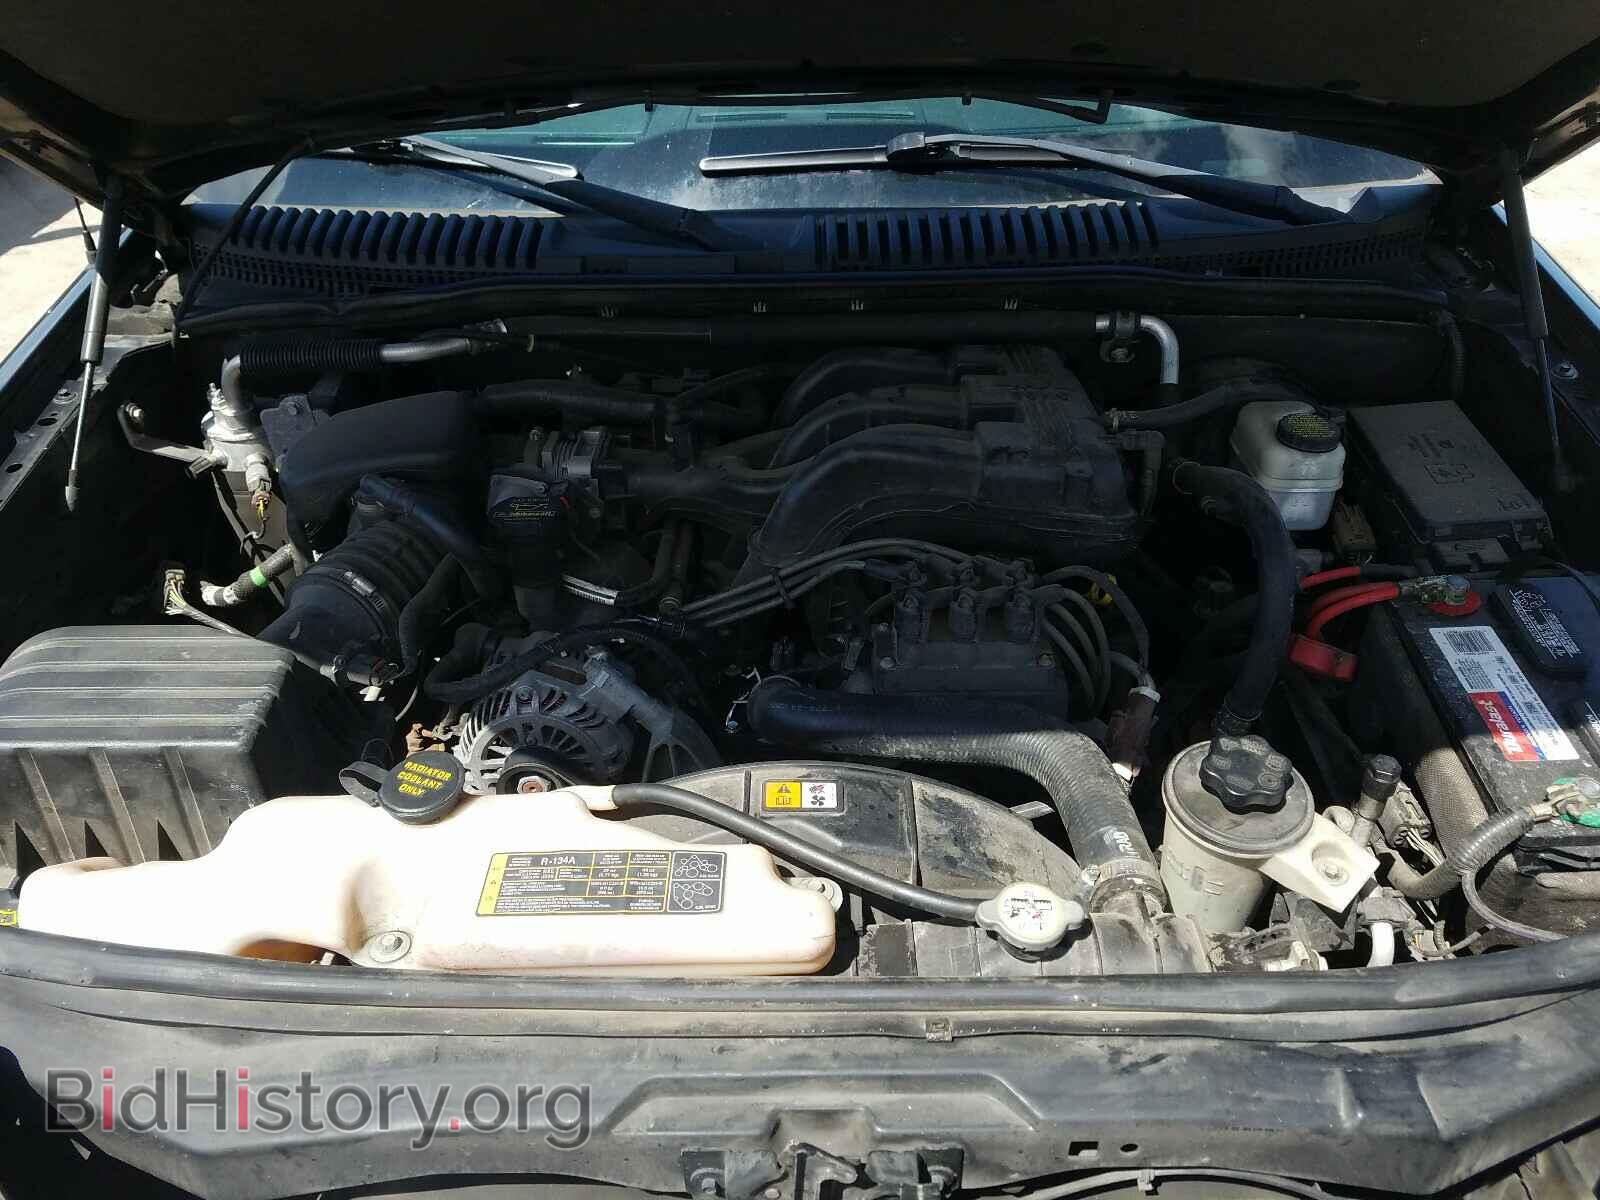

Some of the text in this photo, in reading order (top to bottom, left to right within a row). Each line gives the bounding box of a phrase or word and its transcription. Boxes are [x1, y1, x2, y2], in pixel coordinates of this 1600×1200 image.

[404, 761, 452, 781] RADIATOR
[397, 771, 443, 791] COOLANT
[398, 783, 426, 797] ONLY
[541, 856, 576, 866] R-134A
